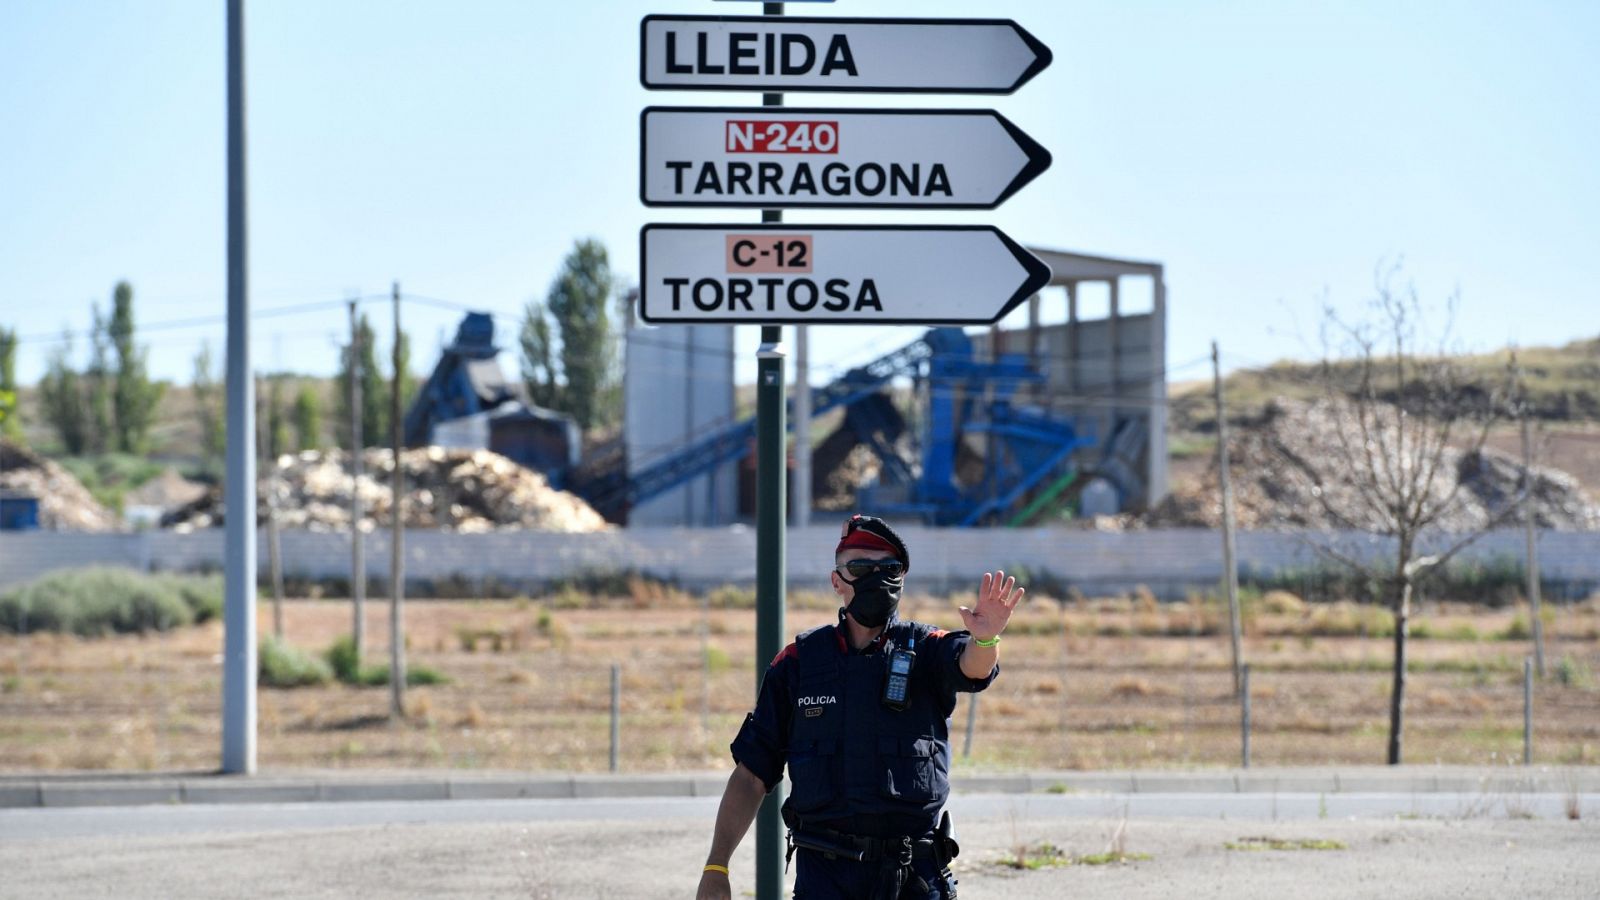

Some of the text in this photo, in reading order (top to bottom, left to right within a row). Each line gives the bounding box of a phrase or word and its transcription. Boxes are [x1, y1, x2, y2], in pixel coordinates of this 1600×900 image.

[666, 31, 859, 76] LLEIDA
[727, 124, 836, 152] N-240
[666, 161, 953, 197] TARRAGONA
[732, 240, 807, 267] C-12
[663, 277, 883, 312] TORTOSA
[798, 696, 837, 707] POLICIA
